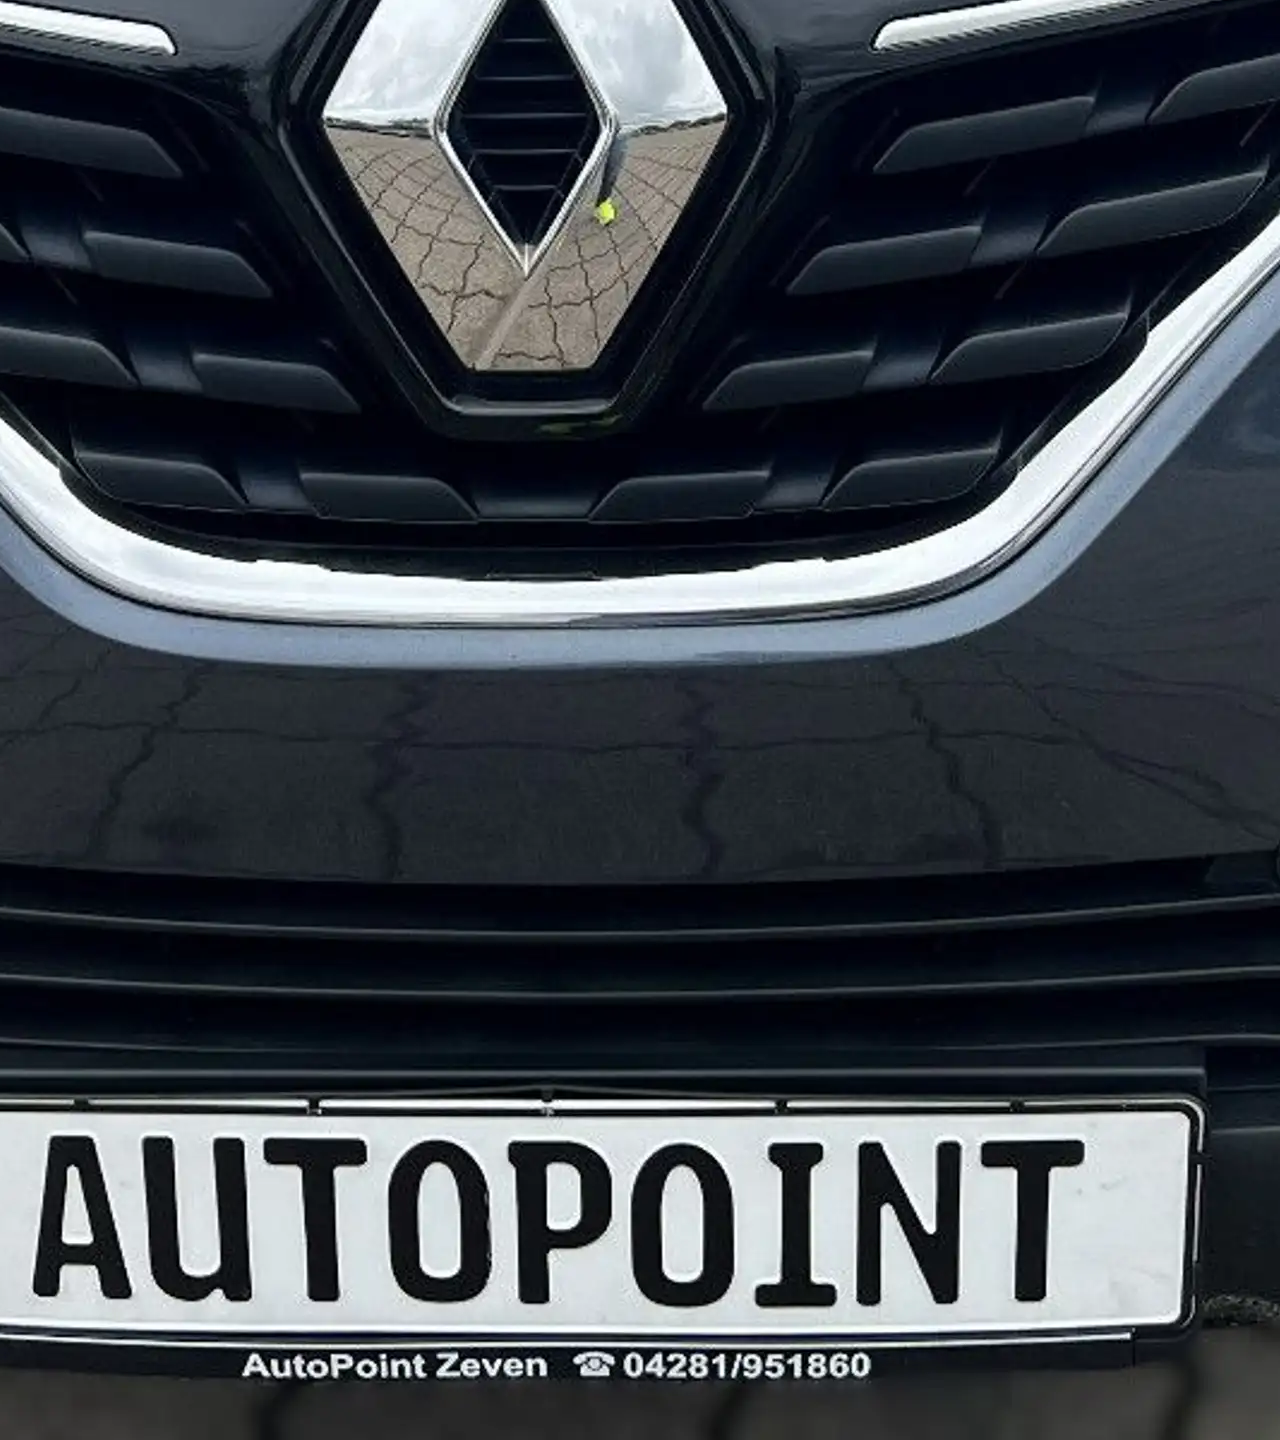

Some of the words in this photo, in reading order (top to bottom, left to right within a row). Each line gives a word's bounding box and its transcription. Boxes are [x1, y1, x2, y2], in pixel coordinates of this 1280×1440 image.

[32, 1134, 1086, 1309] AUTOPOINT
[241, 1352, 428, 1379] AutoPoint
[435, 1352, 548, 1379] Zeven
[623, 1351, 871, 1379] 04281/951860
